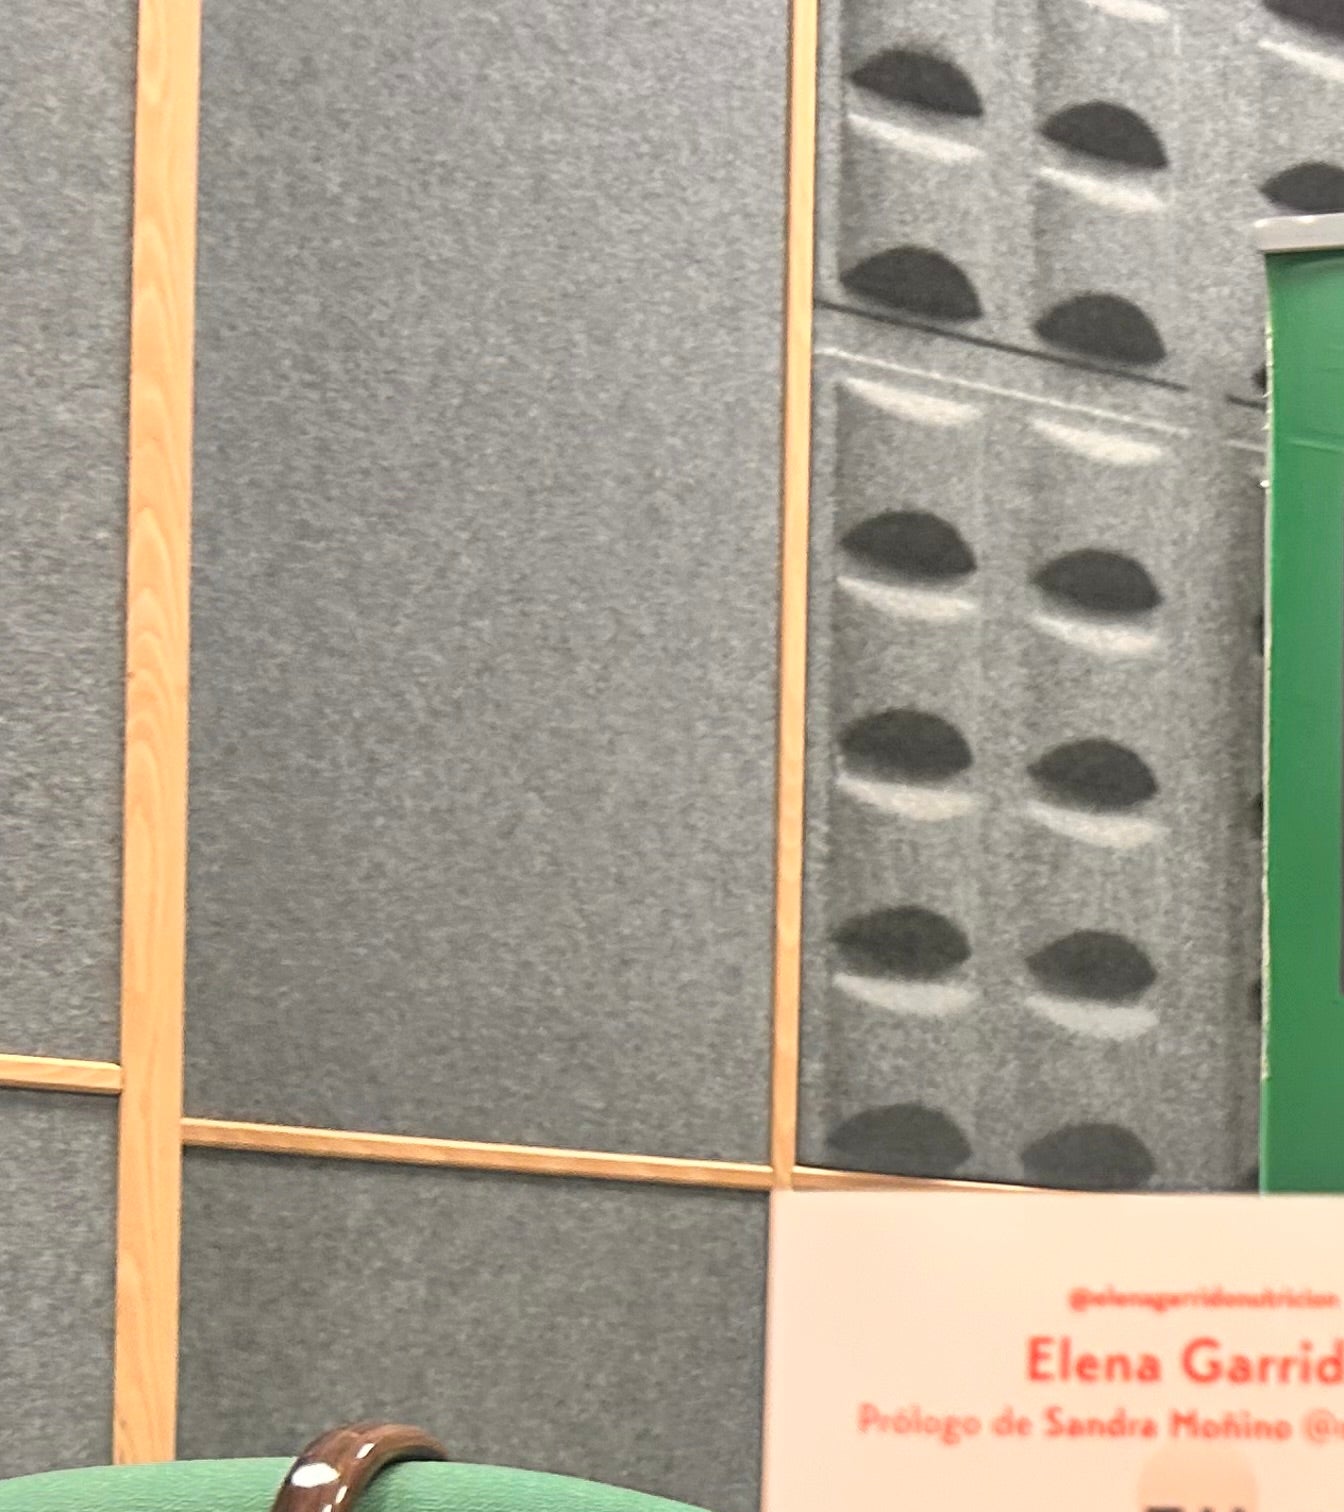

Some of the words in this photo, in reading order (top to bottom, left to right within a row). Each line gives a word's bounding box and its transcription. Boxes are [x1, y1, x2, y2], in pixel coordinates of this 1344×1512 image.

[1067, 1286, 1340, 1314] @elenagarridonutricion
[1026, 1335, 1162, 1385] Elena
[857, 1401, 981, 1446] Prólogo
[992, 1404, 1032, 1438] de
[1045, 1406, 1158, 1441] Sandra
[1172, 1407, 1293, 1443] Moñino
